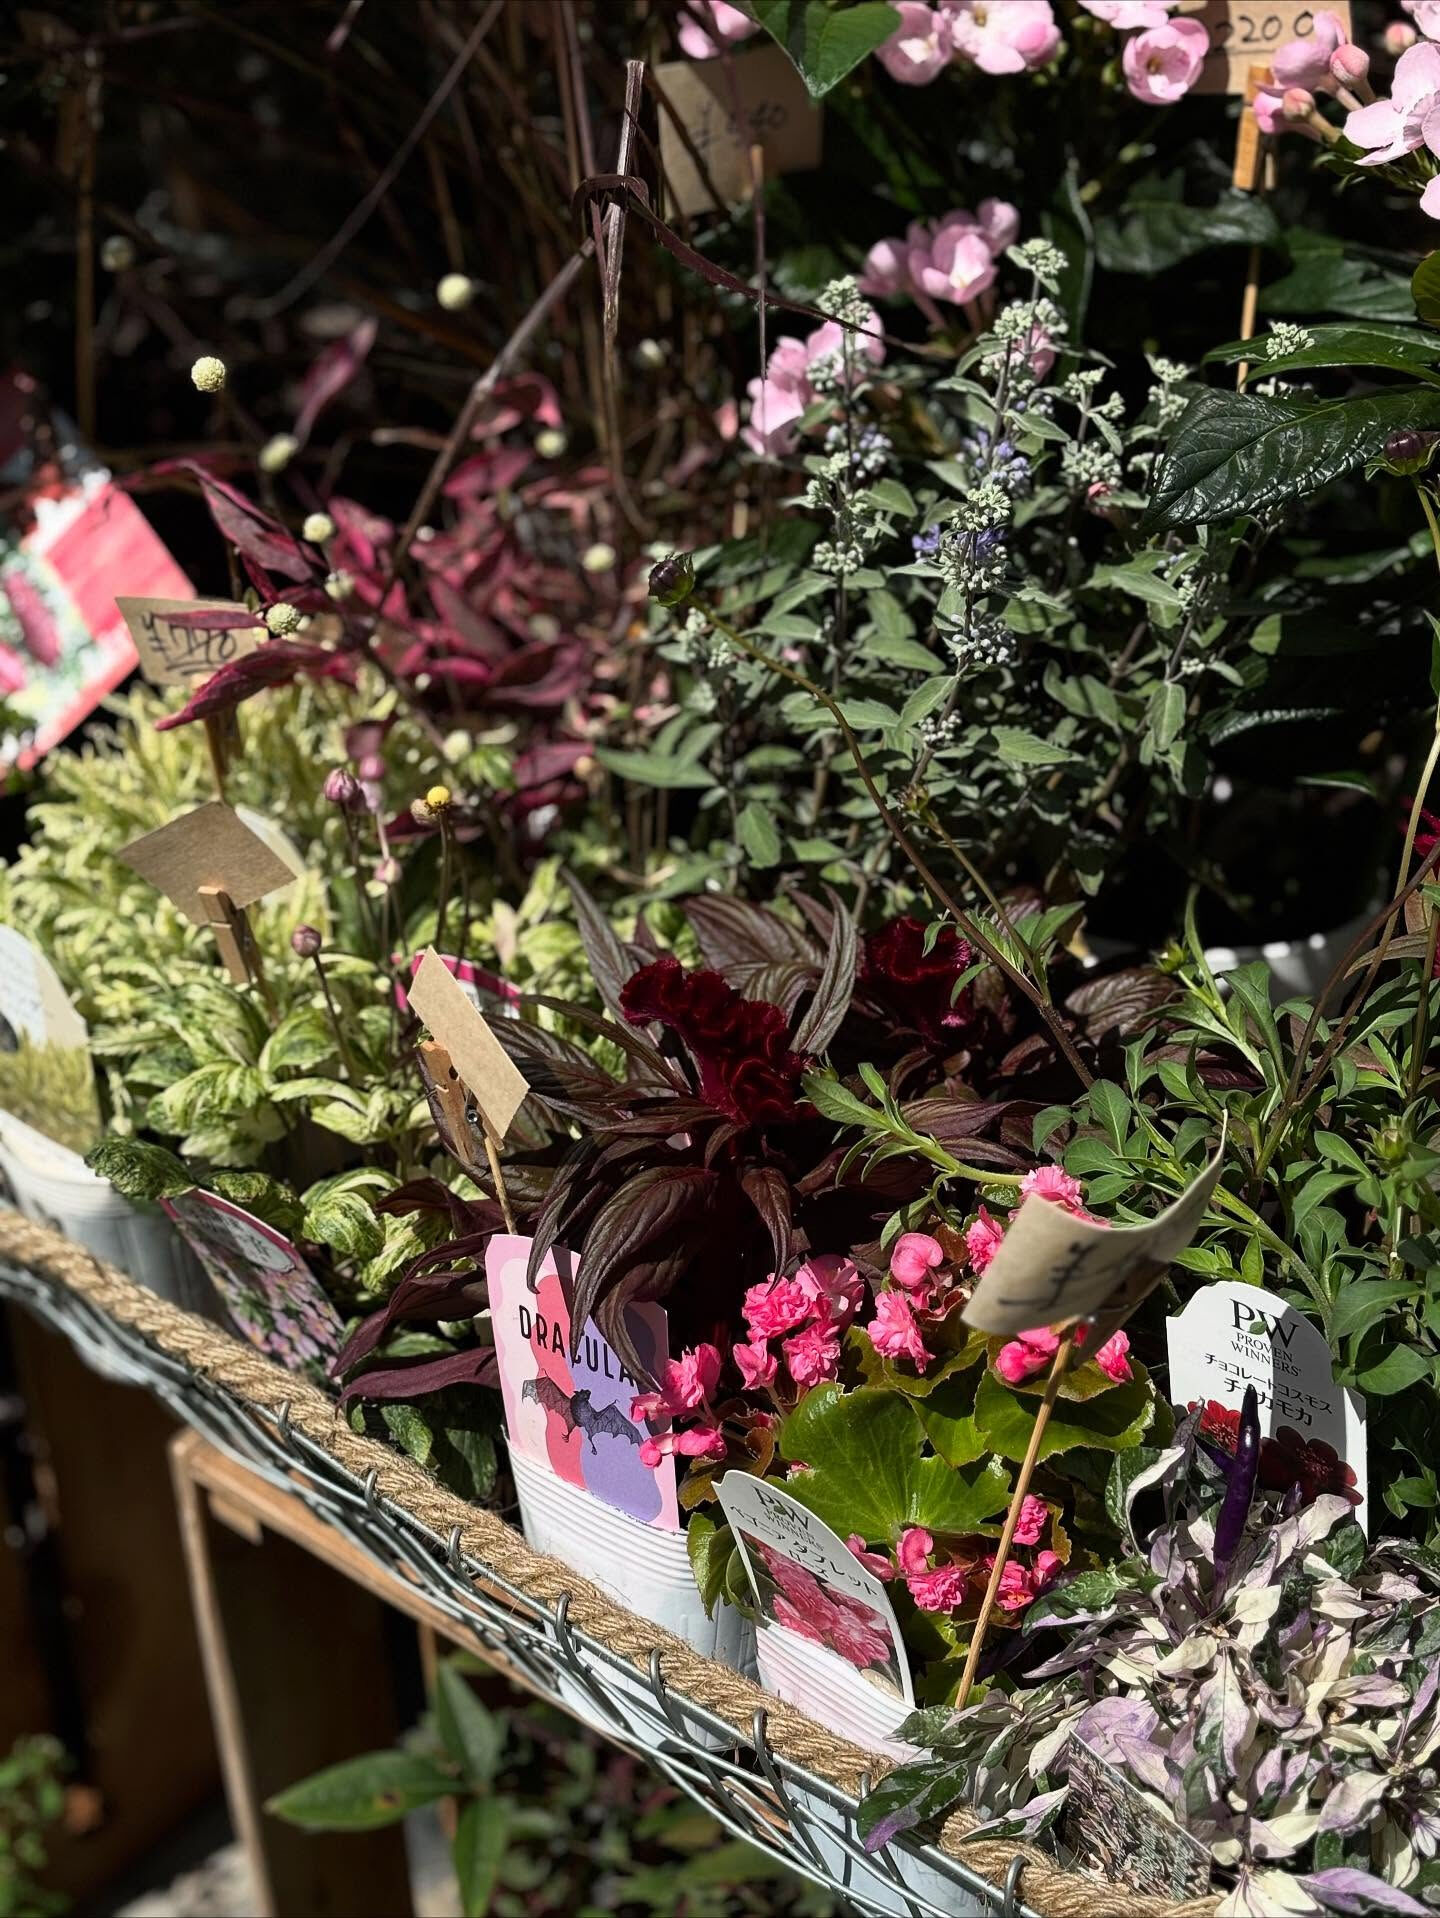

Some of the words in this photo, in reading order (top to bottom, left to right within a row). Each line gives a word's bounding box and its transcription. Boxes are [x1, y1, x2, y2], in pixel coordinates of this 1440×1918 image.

[1229, 1298, 1299, 1348] PW
[1231, 1340, 1299, 1377] WINNERS
[1236, 1332, 1293, 1362] PROVEN
[1205, 1353, 1332, 1414] チョコレートコスモス
[1224, 1377, 1313, 1426] チカモカ
[752, 1485, 809, 1530] PW
